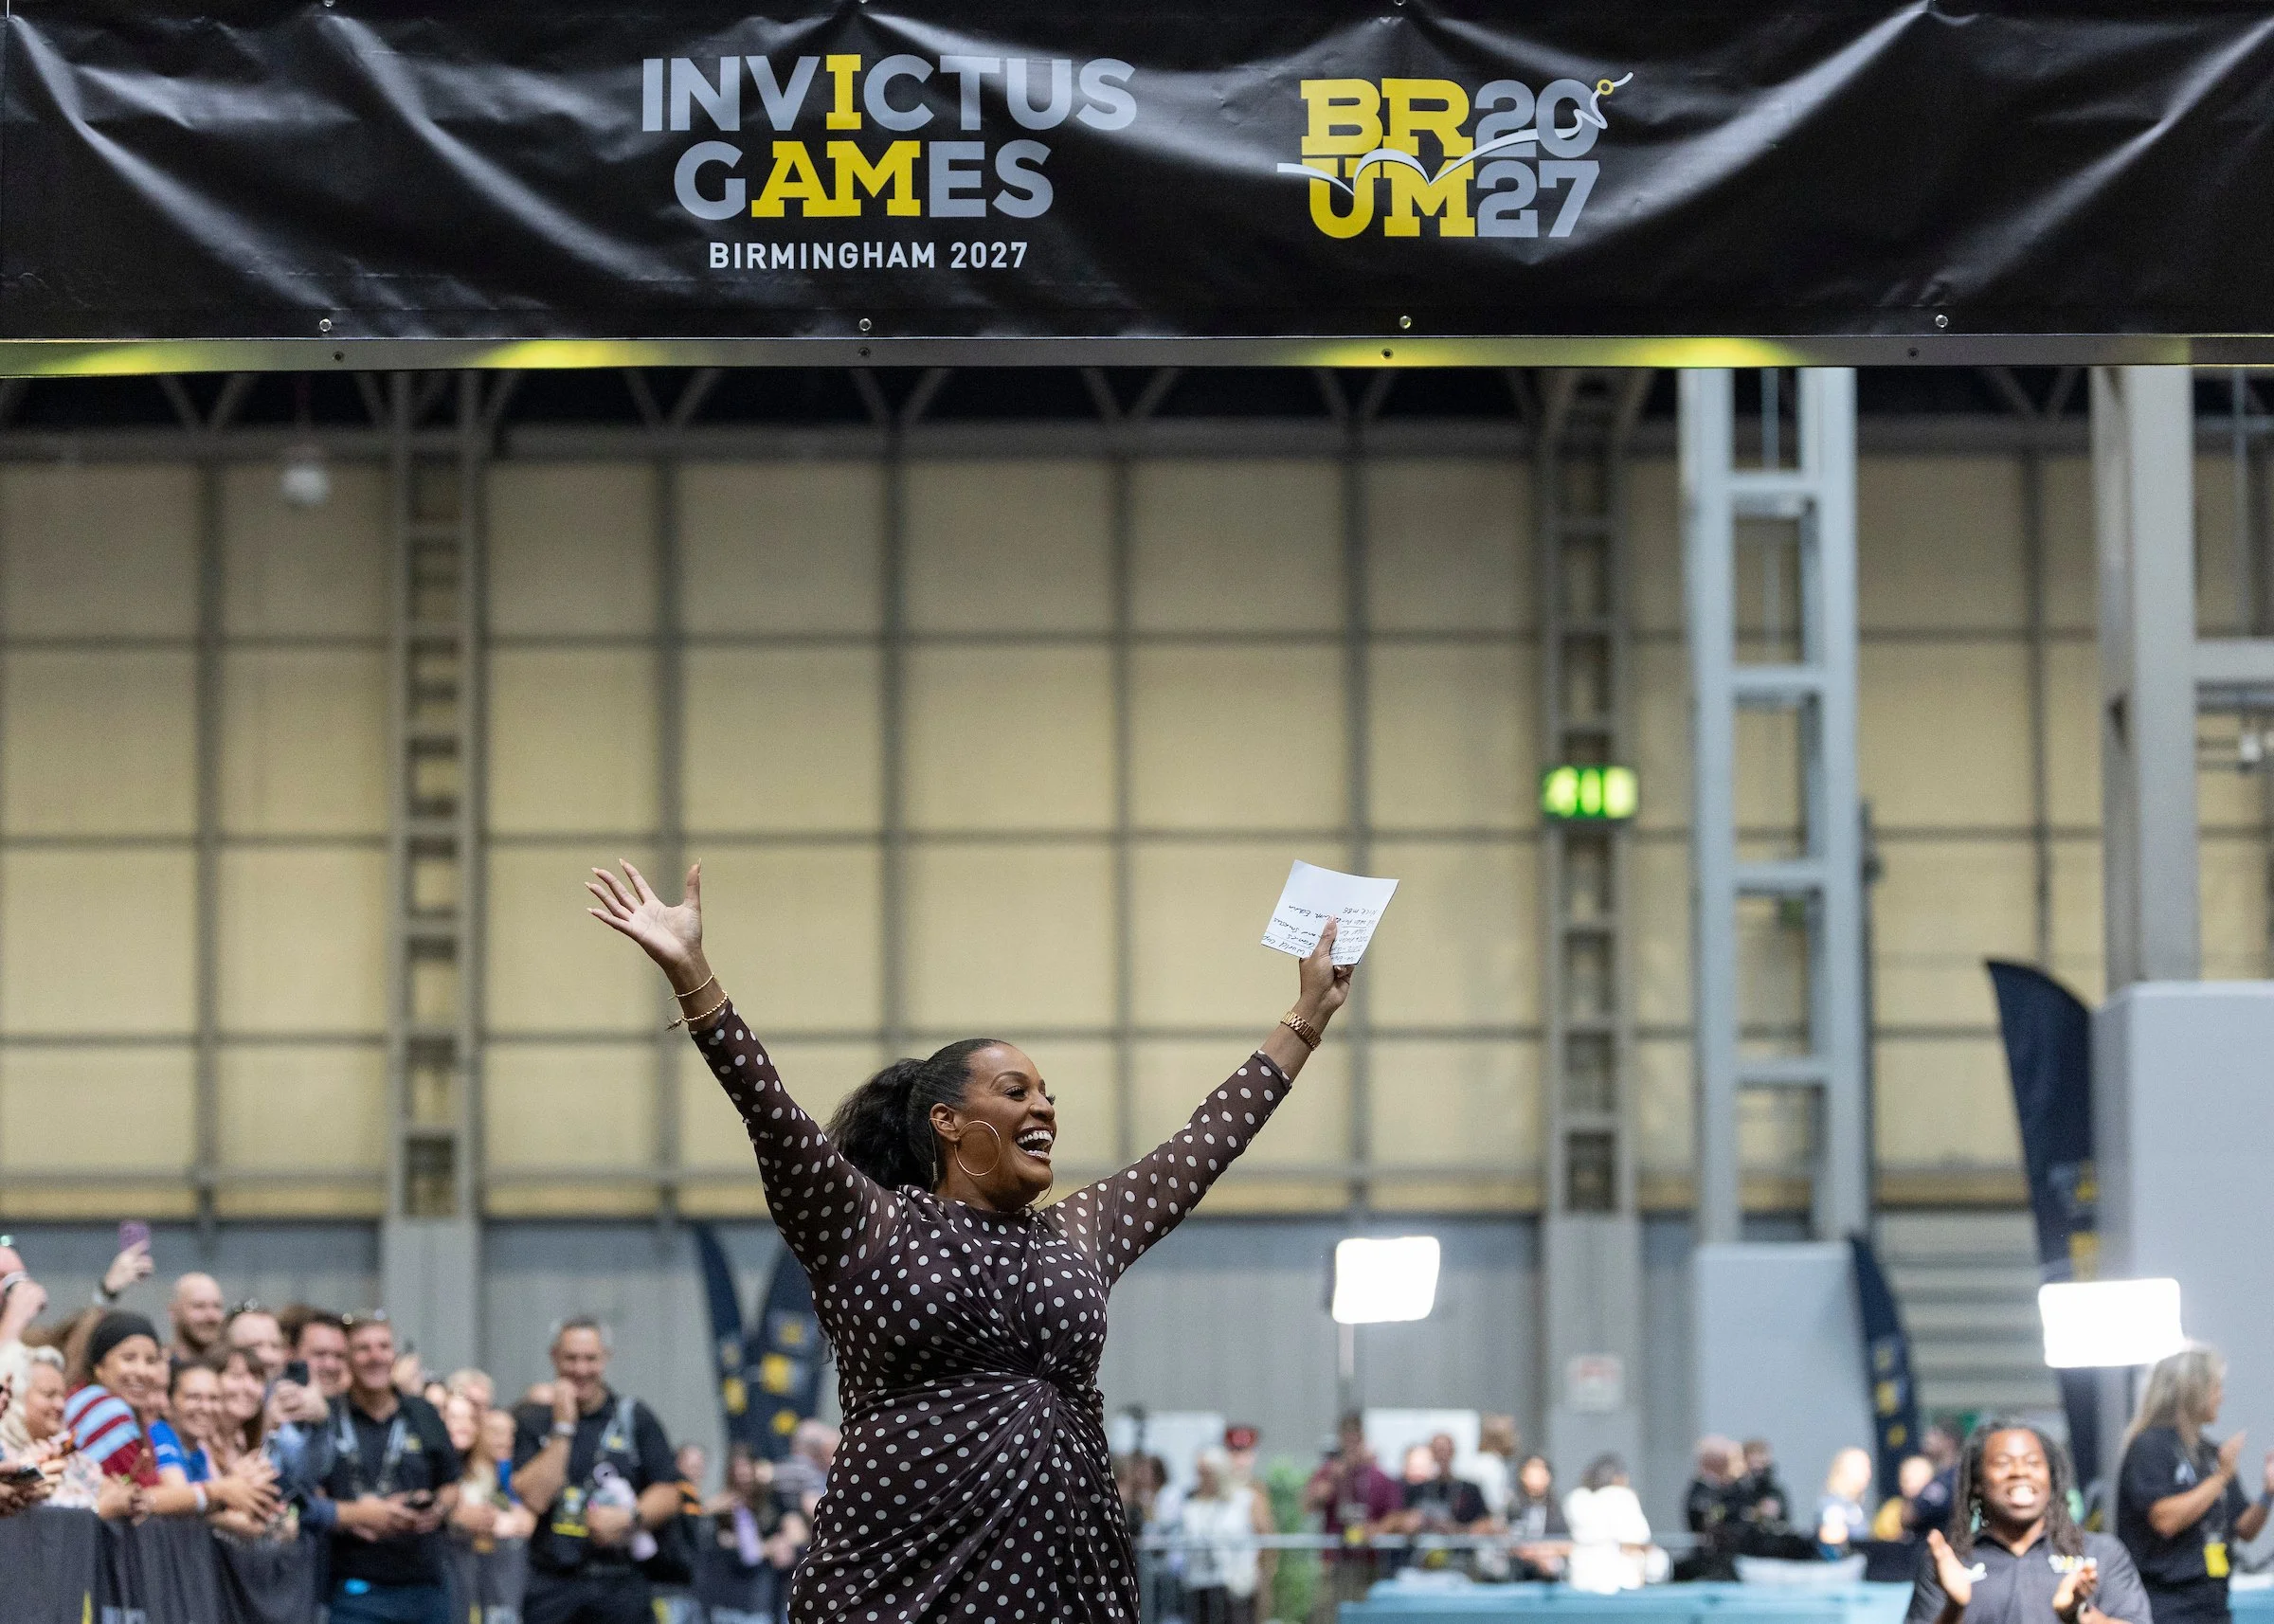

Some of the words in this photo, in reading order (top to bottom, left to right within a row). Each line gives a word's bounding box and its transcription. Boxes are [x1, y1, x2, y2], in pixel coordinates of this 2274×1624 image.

[641, 54, 1137, 132] INVICTUS
[674, 138, 1054, 220] GAMES
[709, 241, 936, 270] BIRMINGHAM
[950, 241, 1028, 269] 2027
